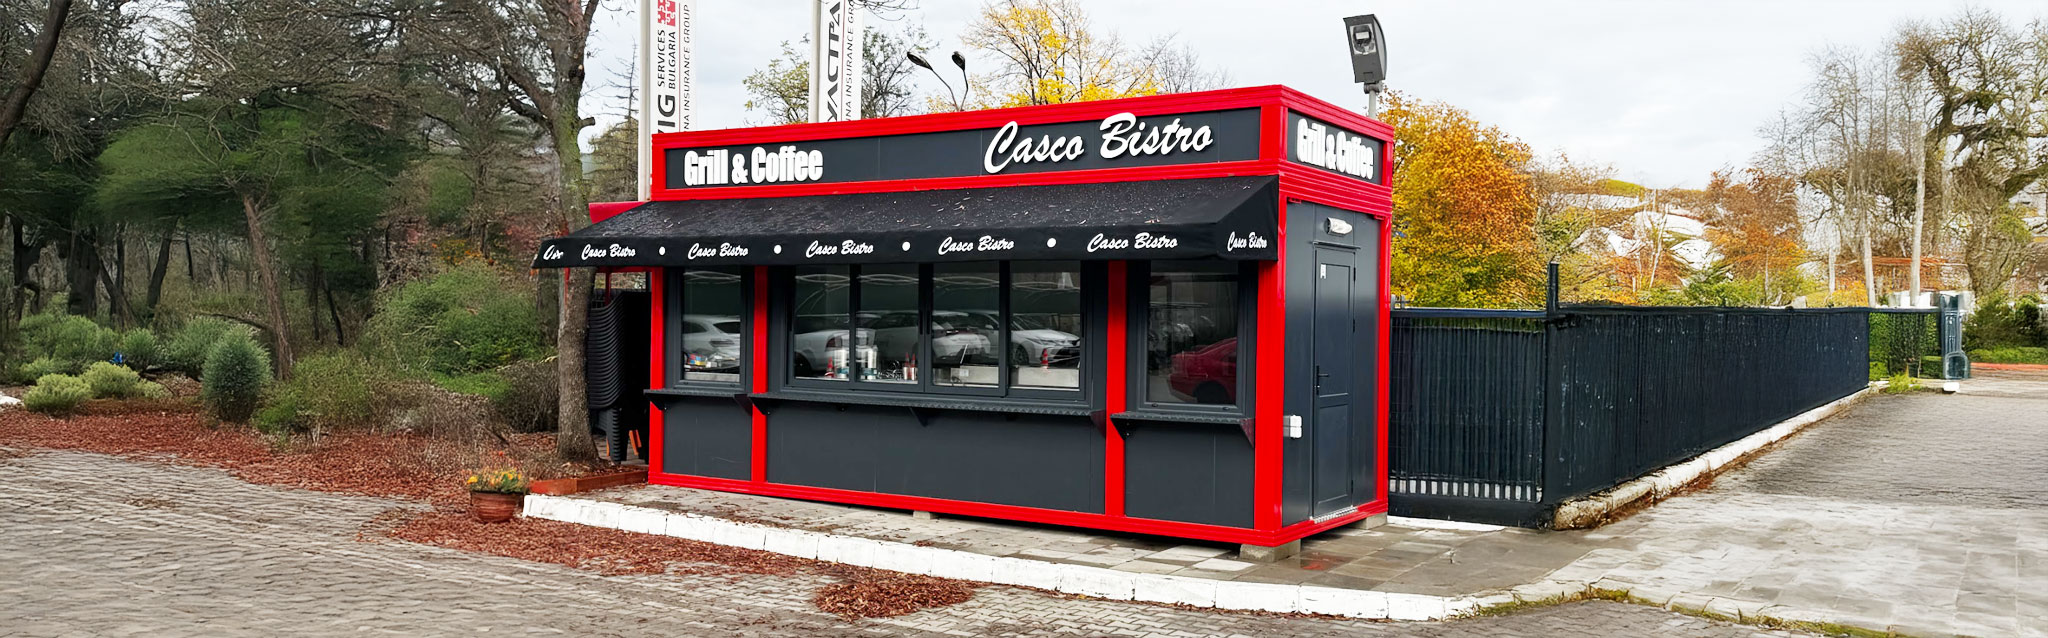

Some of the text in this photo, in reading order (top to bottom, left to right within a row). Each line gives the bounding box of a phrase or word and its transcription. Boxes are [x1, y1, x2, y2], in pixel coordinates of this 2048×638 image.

[683, 4, 691, 43] GROUP
[657, 29, 666, 87] SERVICES
[668, 31, 676, 90] BULGARIA
[846, 27, 854, 97] INSURANCE
[683, 46, 691, 111] INSURANCE
[657, 94, 676, 134] IG
[984, 112, 1214, 174] Casco Bistro
[1297, 118, 1374, 180] Grill & Coffee
[684, 145, 824, 187] Grill & Coffee
[581, 243, 607, 261] Casco
[609, 243, 636, 258] Bistro
[688, 242, 749, 260] Casco Bistro
[806, 239, 874, 258] Casco Bistro
[938, 235, 1015, 255] Casco Bistro
[1086, 231, 1178, 253] Casco Bistro
[1227, 231, 1268, 252] Casco Bistro
